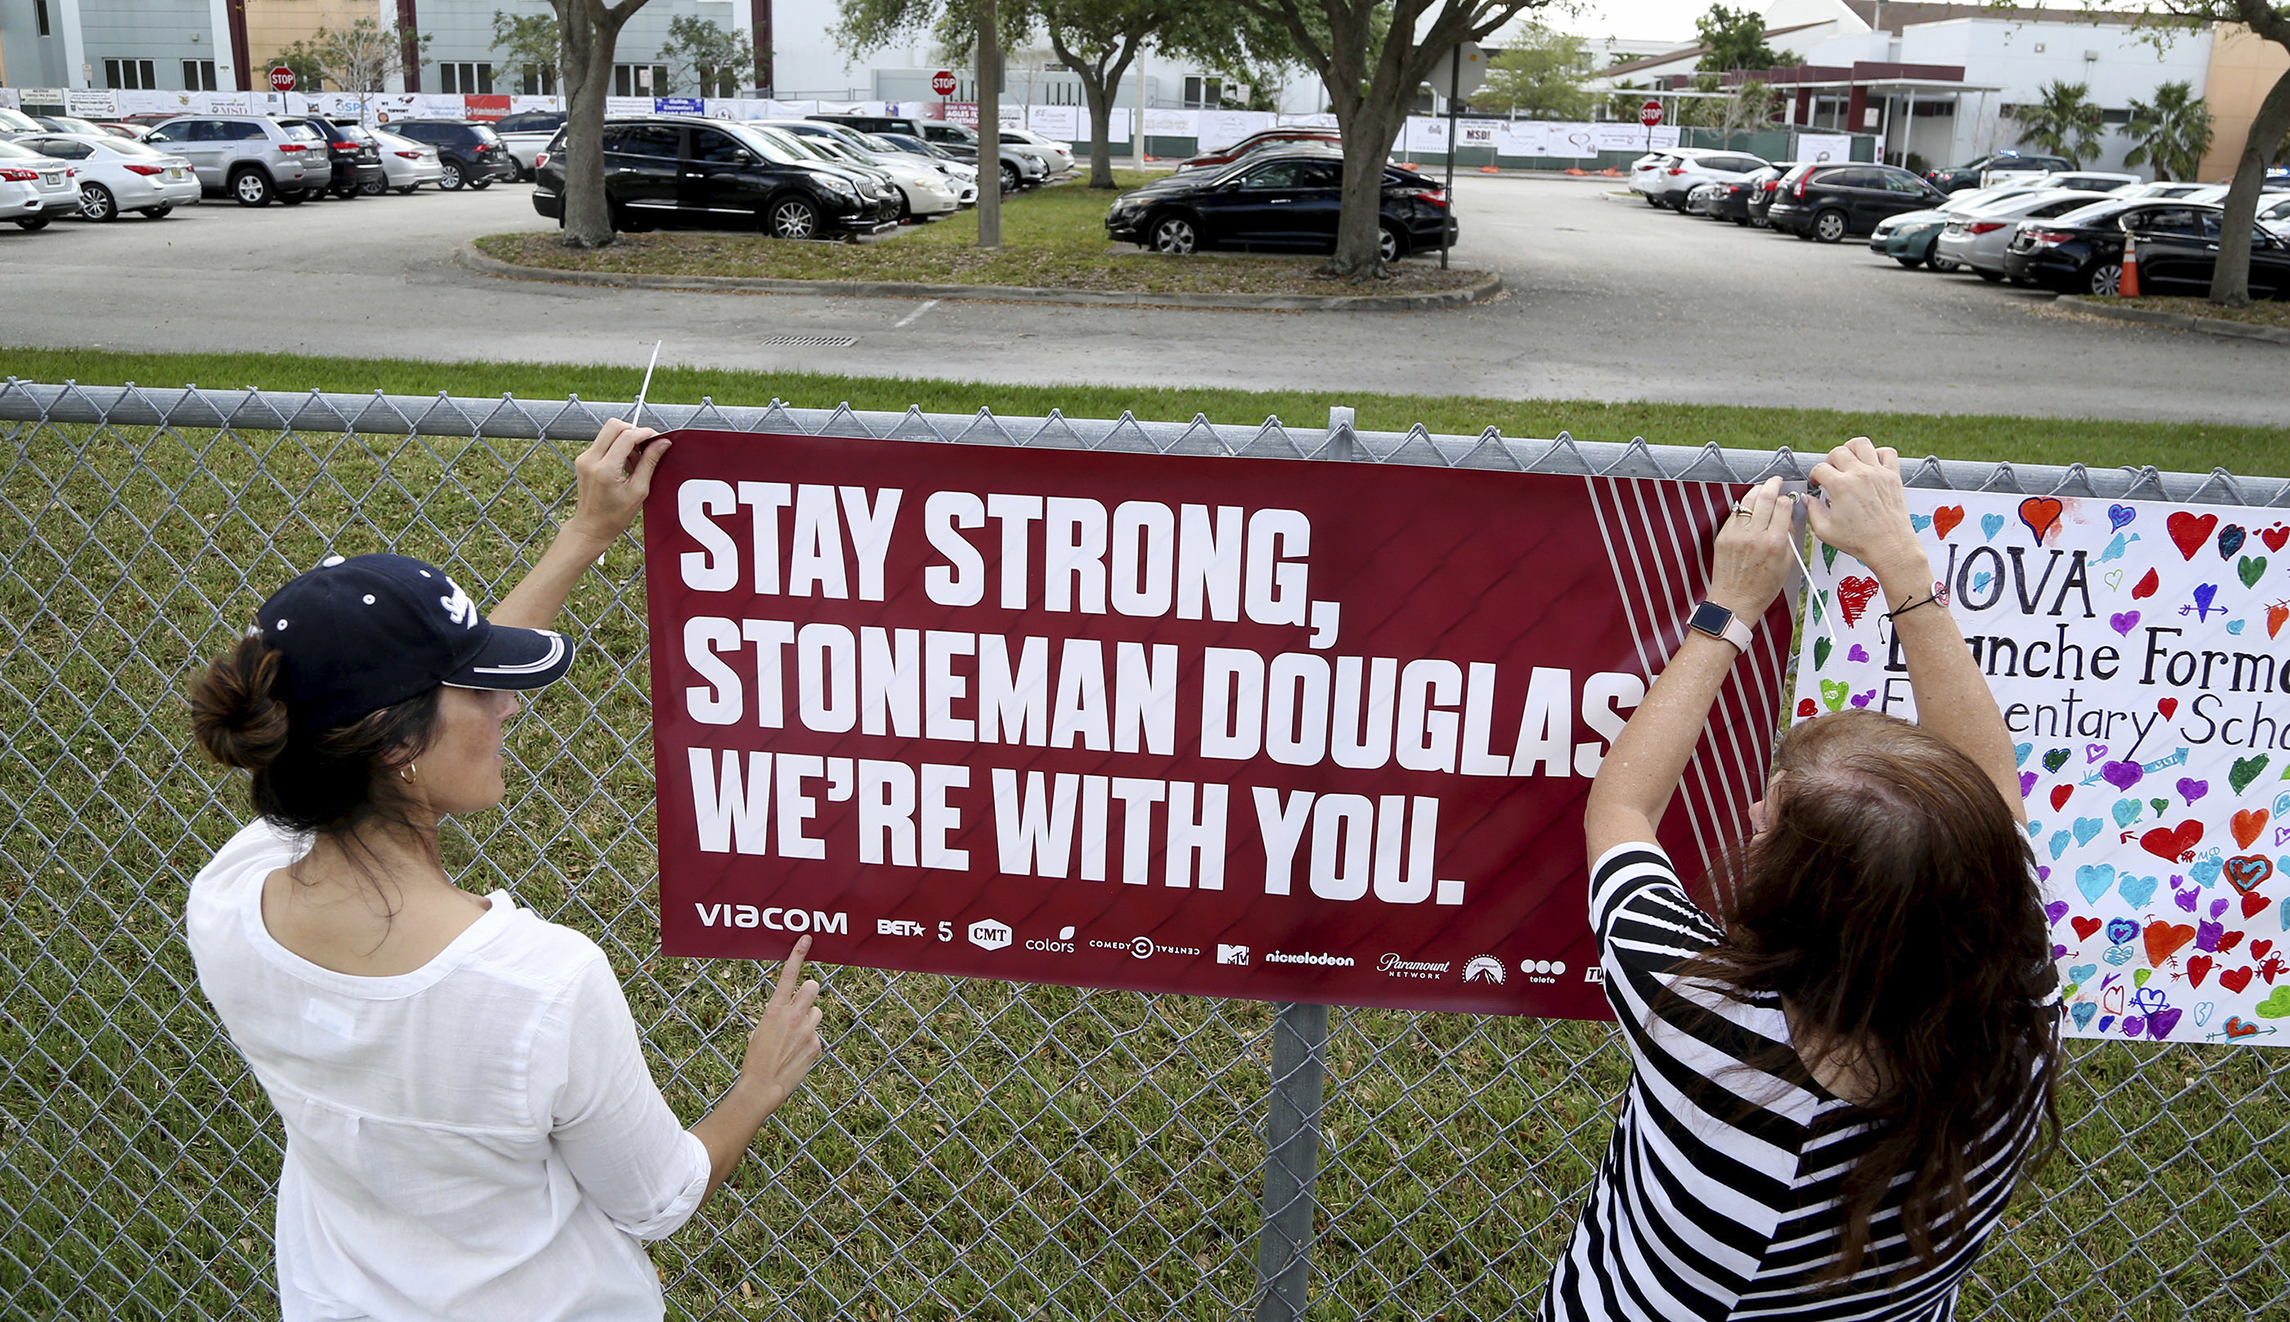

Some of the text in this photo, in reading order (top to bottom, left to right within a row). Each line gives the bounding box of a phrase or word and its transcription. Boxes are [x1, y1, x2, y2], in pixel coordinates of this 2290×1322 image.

[271, 74, 294, 85] STOP
[932, 78, 956, 89] STOP
[1640, 108, 1663, 119] STOP
[1466, 130, 1492, 140] MSD!
[678, 478, 1341, 649] STAY STRONG,
[683, 616, 1646, 778] STONEMAN DOUGLAS
[991, 768, 1229, 890] WITH
[1252, 786, 1466, 905] YOU.
[877, 918, 917, 937] BET
[937, 920, 954, 942] 5
[973, 926, 1008, 943] CMT
[1025, 937, 1075, 954] colors
[1089, 939, 1201, 956] COMEDY CENTRAL
[1216, 943, 1250, 967] MTV
[1265, 949, 1355, 967] nickelodeon
[1376, 952, 1451, 973] Paramount
[1388, 970, 1441, 980] NETWORK
[1529, 976, 1556, 985] telefe
